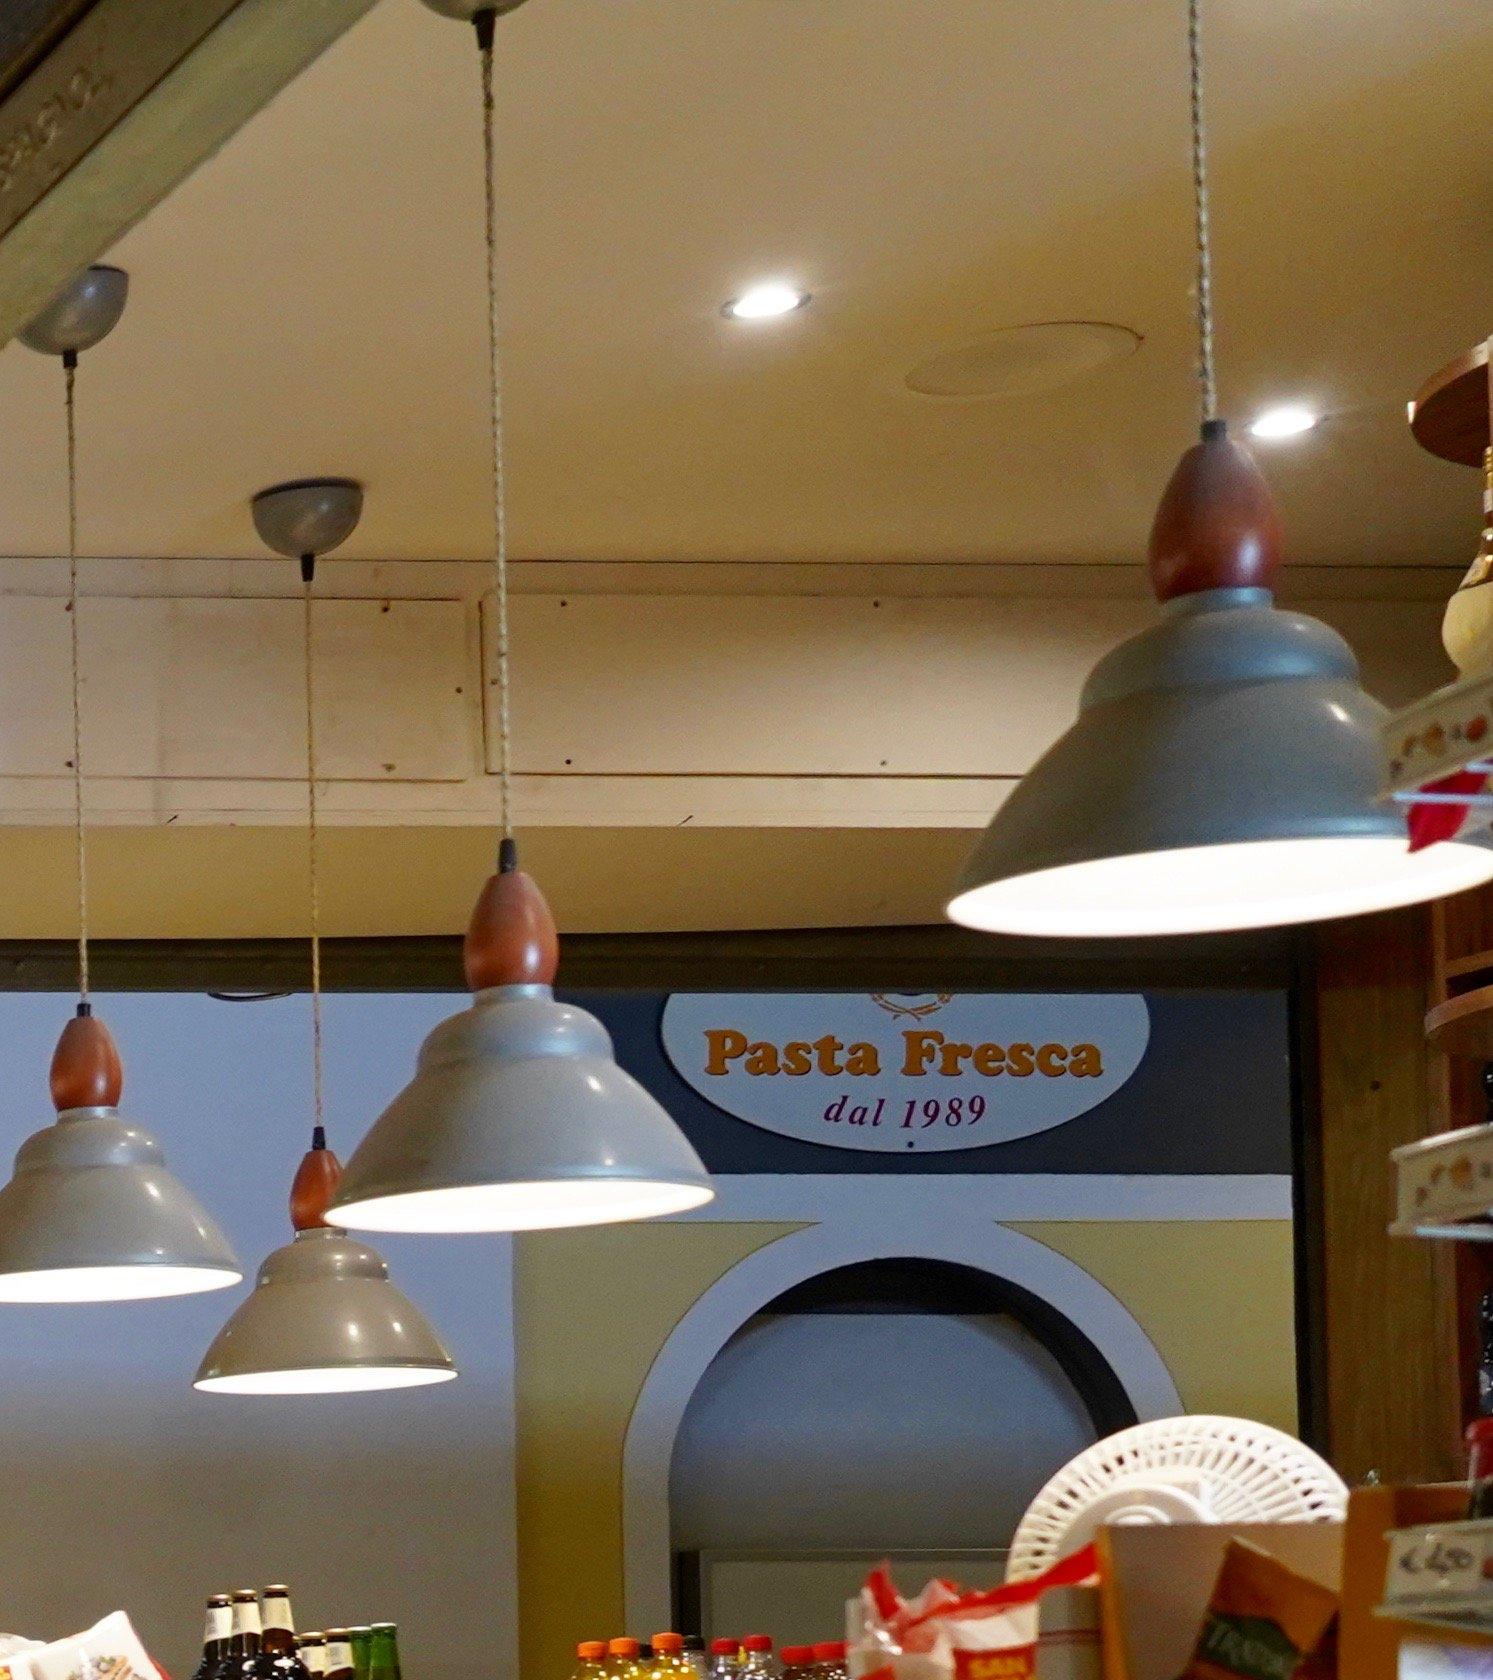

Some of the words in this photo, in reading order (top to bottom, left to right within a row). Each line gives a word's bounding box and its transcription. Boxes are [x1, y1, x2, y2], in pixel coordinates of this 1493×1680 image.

[704, 1030, 881, 1077] Pasta
[900, 1030, 1104, 1078] Fresca
[823, 1095, 886, 1128] dal
[899, 1095, 987, 1130] 1989
